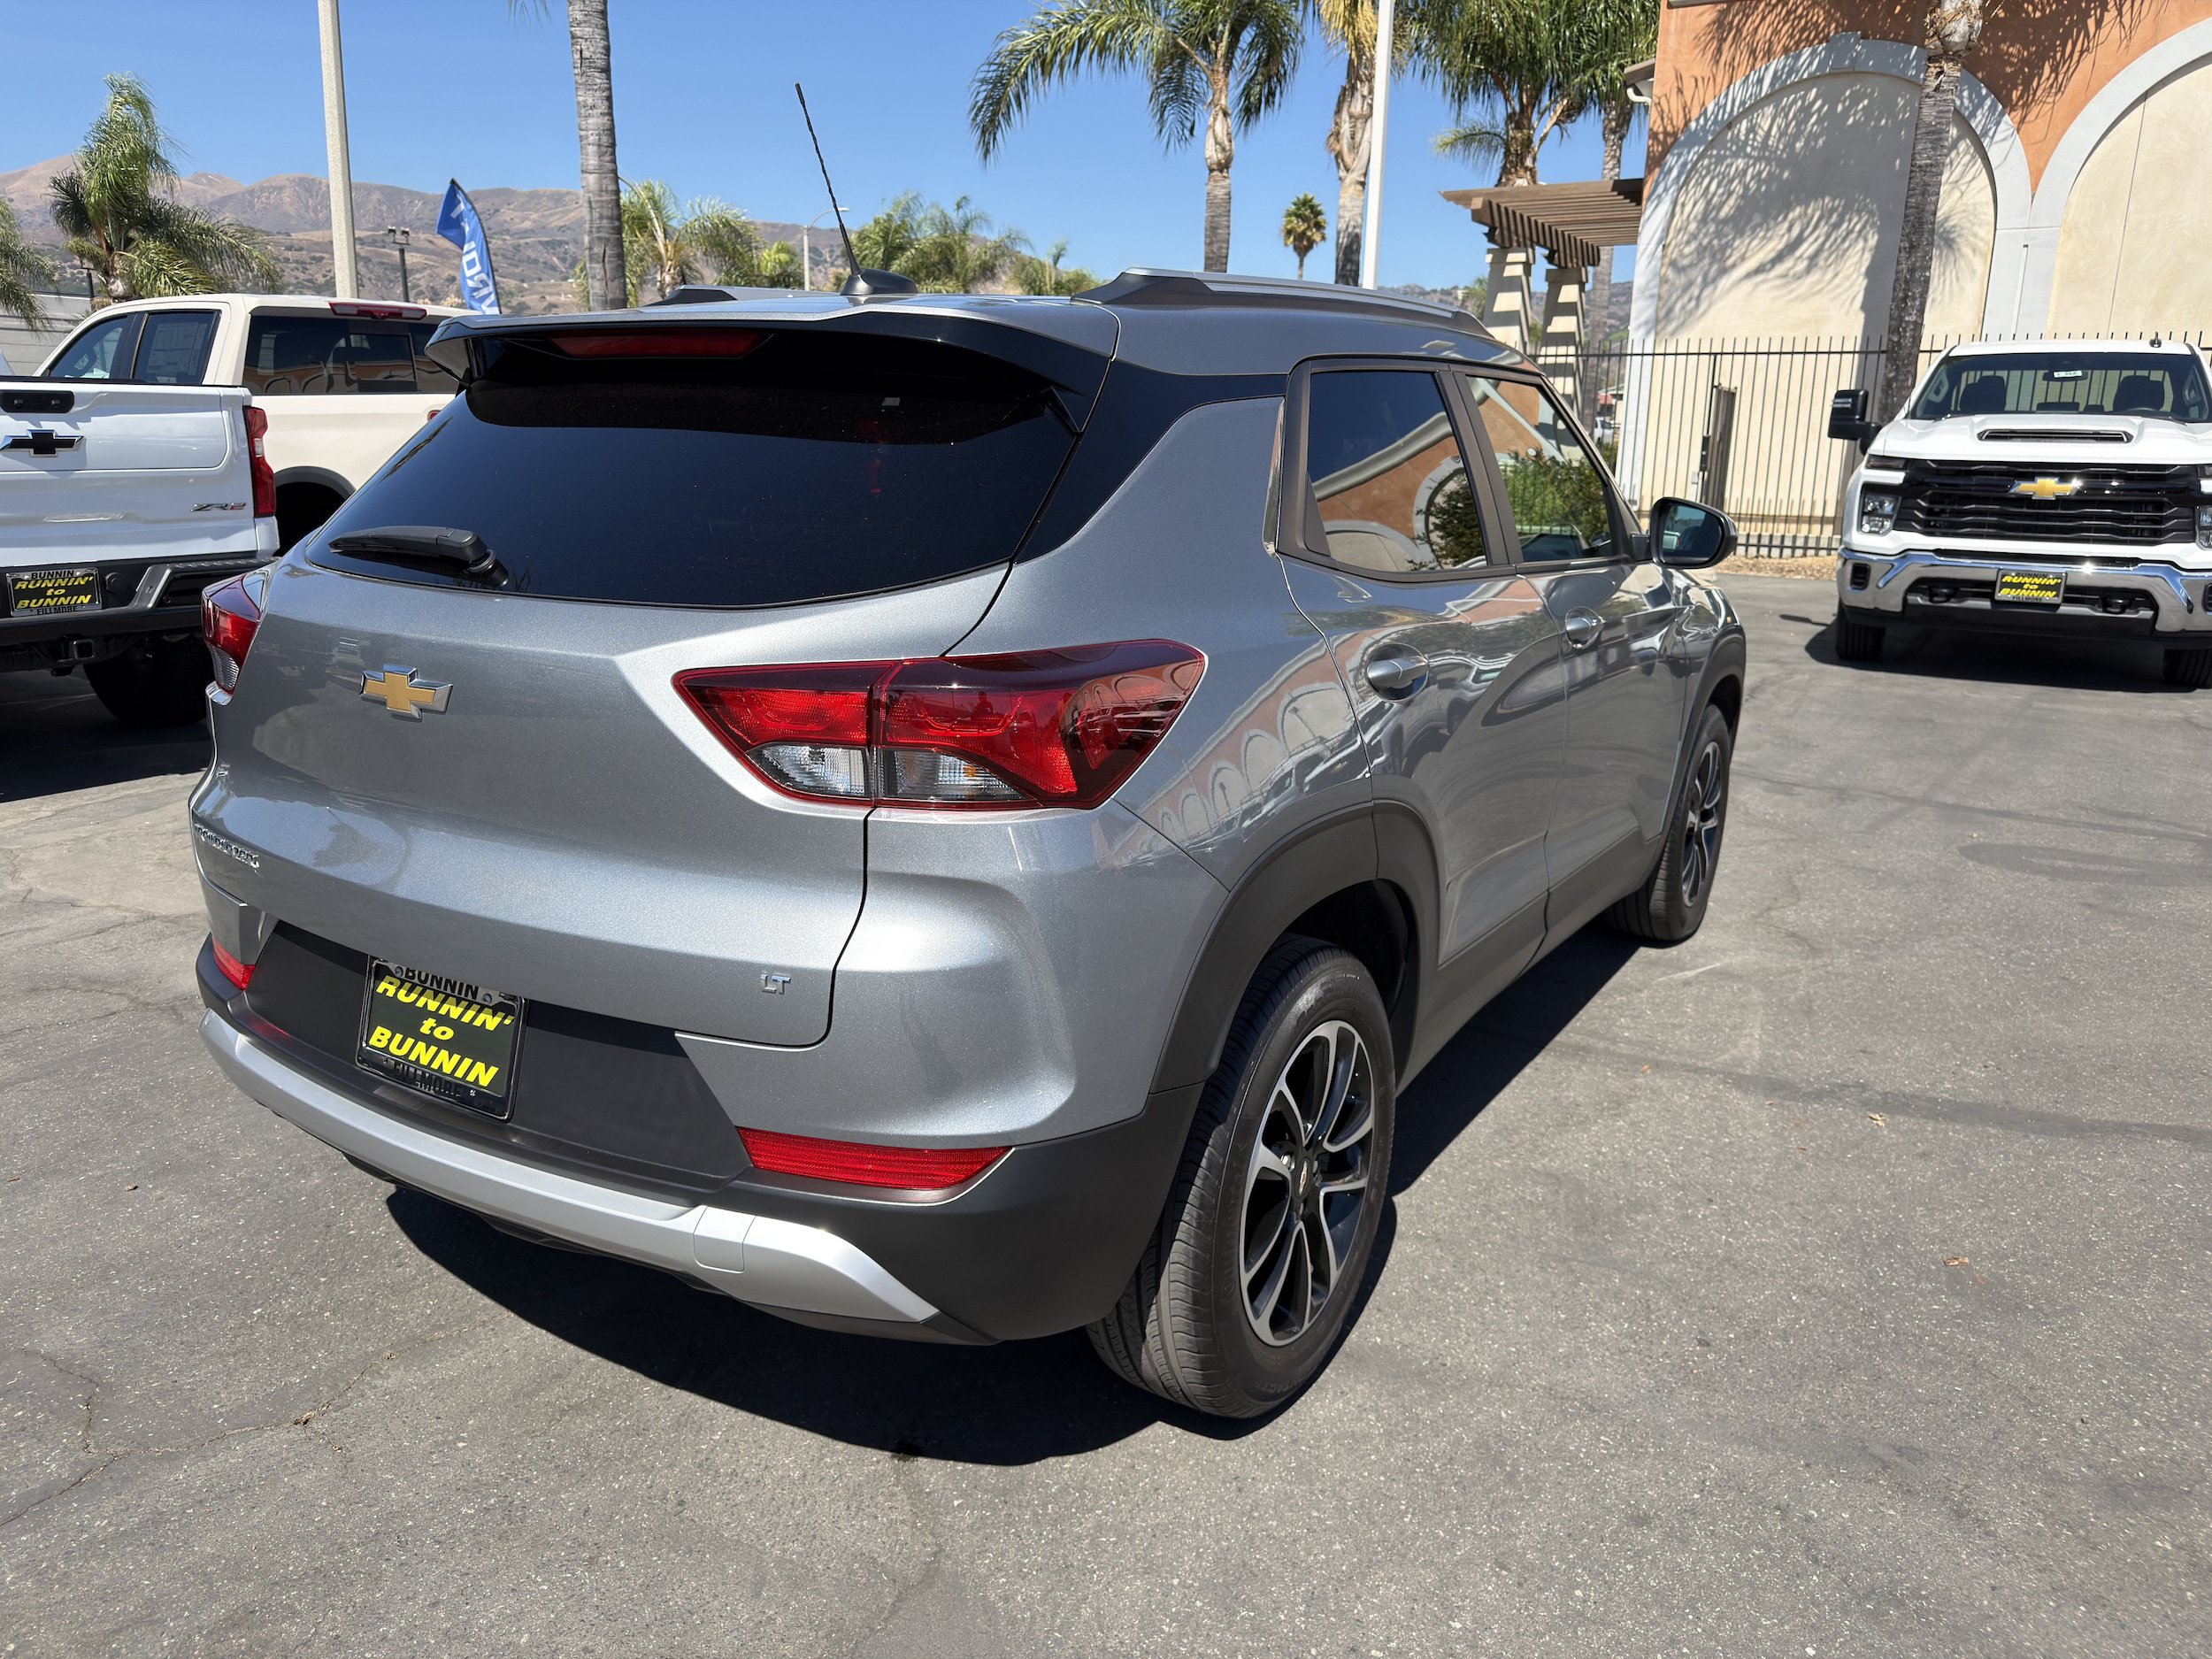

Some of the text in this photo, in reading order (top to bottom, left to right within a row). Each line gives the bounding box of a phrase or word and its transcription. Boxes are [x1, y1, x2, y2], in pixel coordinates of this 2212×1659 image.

[189, 502, 247, 512] ZR2
[31, 570, 74, 580] BUNNIN
[2001, 575, 2062, 585] RUNNIN'
[14, 576, 94, 590] RUNNIN'
[2000, 588, 2057, 598] BUNNIN
[16, 594, 92, 610] BUNNIN
[36, 605, 79, 615] FILLMORE
[405, 967, 480, 1000] BUNNIN
[759, 973, 792, 995] LT
[375, 975, 515, 1031] RUNNIN'
[419, 1018, 455, 1041] to
[368, 1025, 500, 1087] BUNNIN
